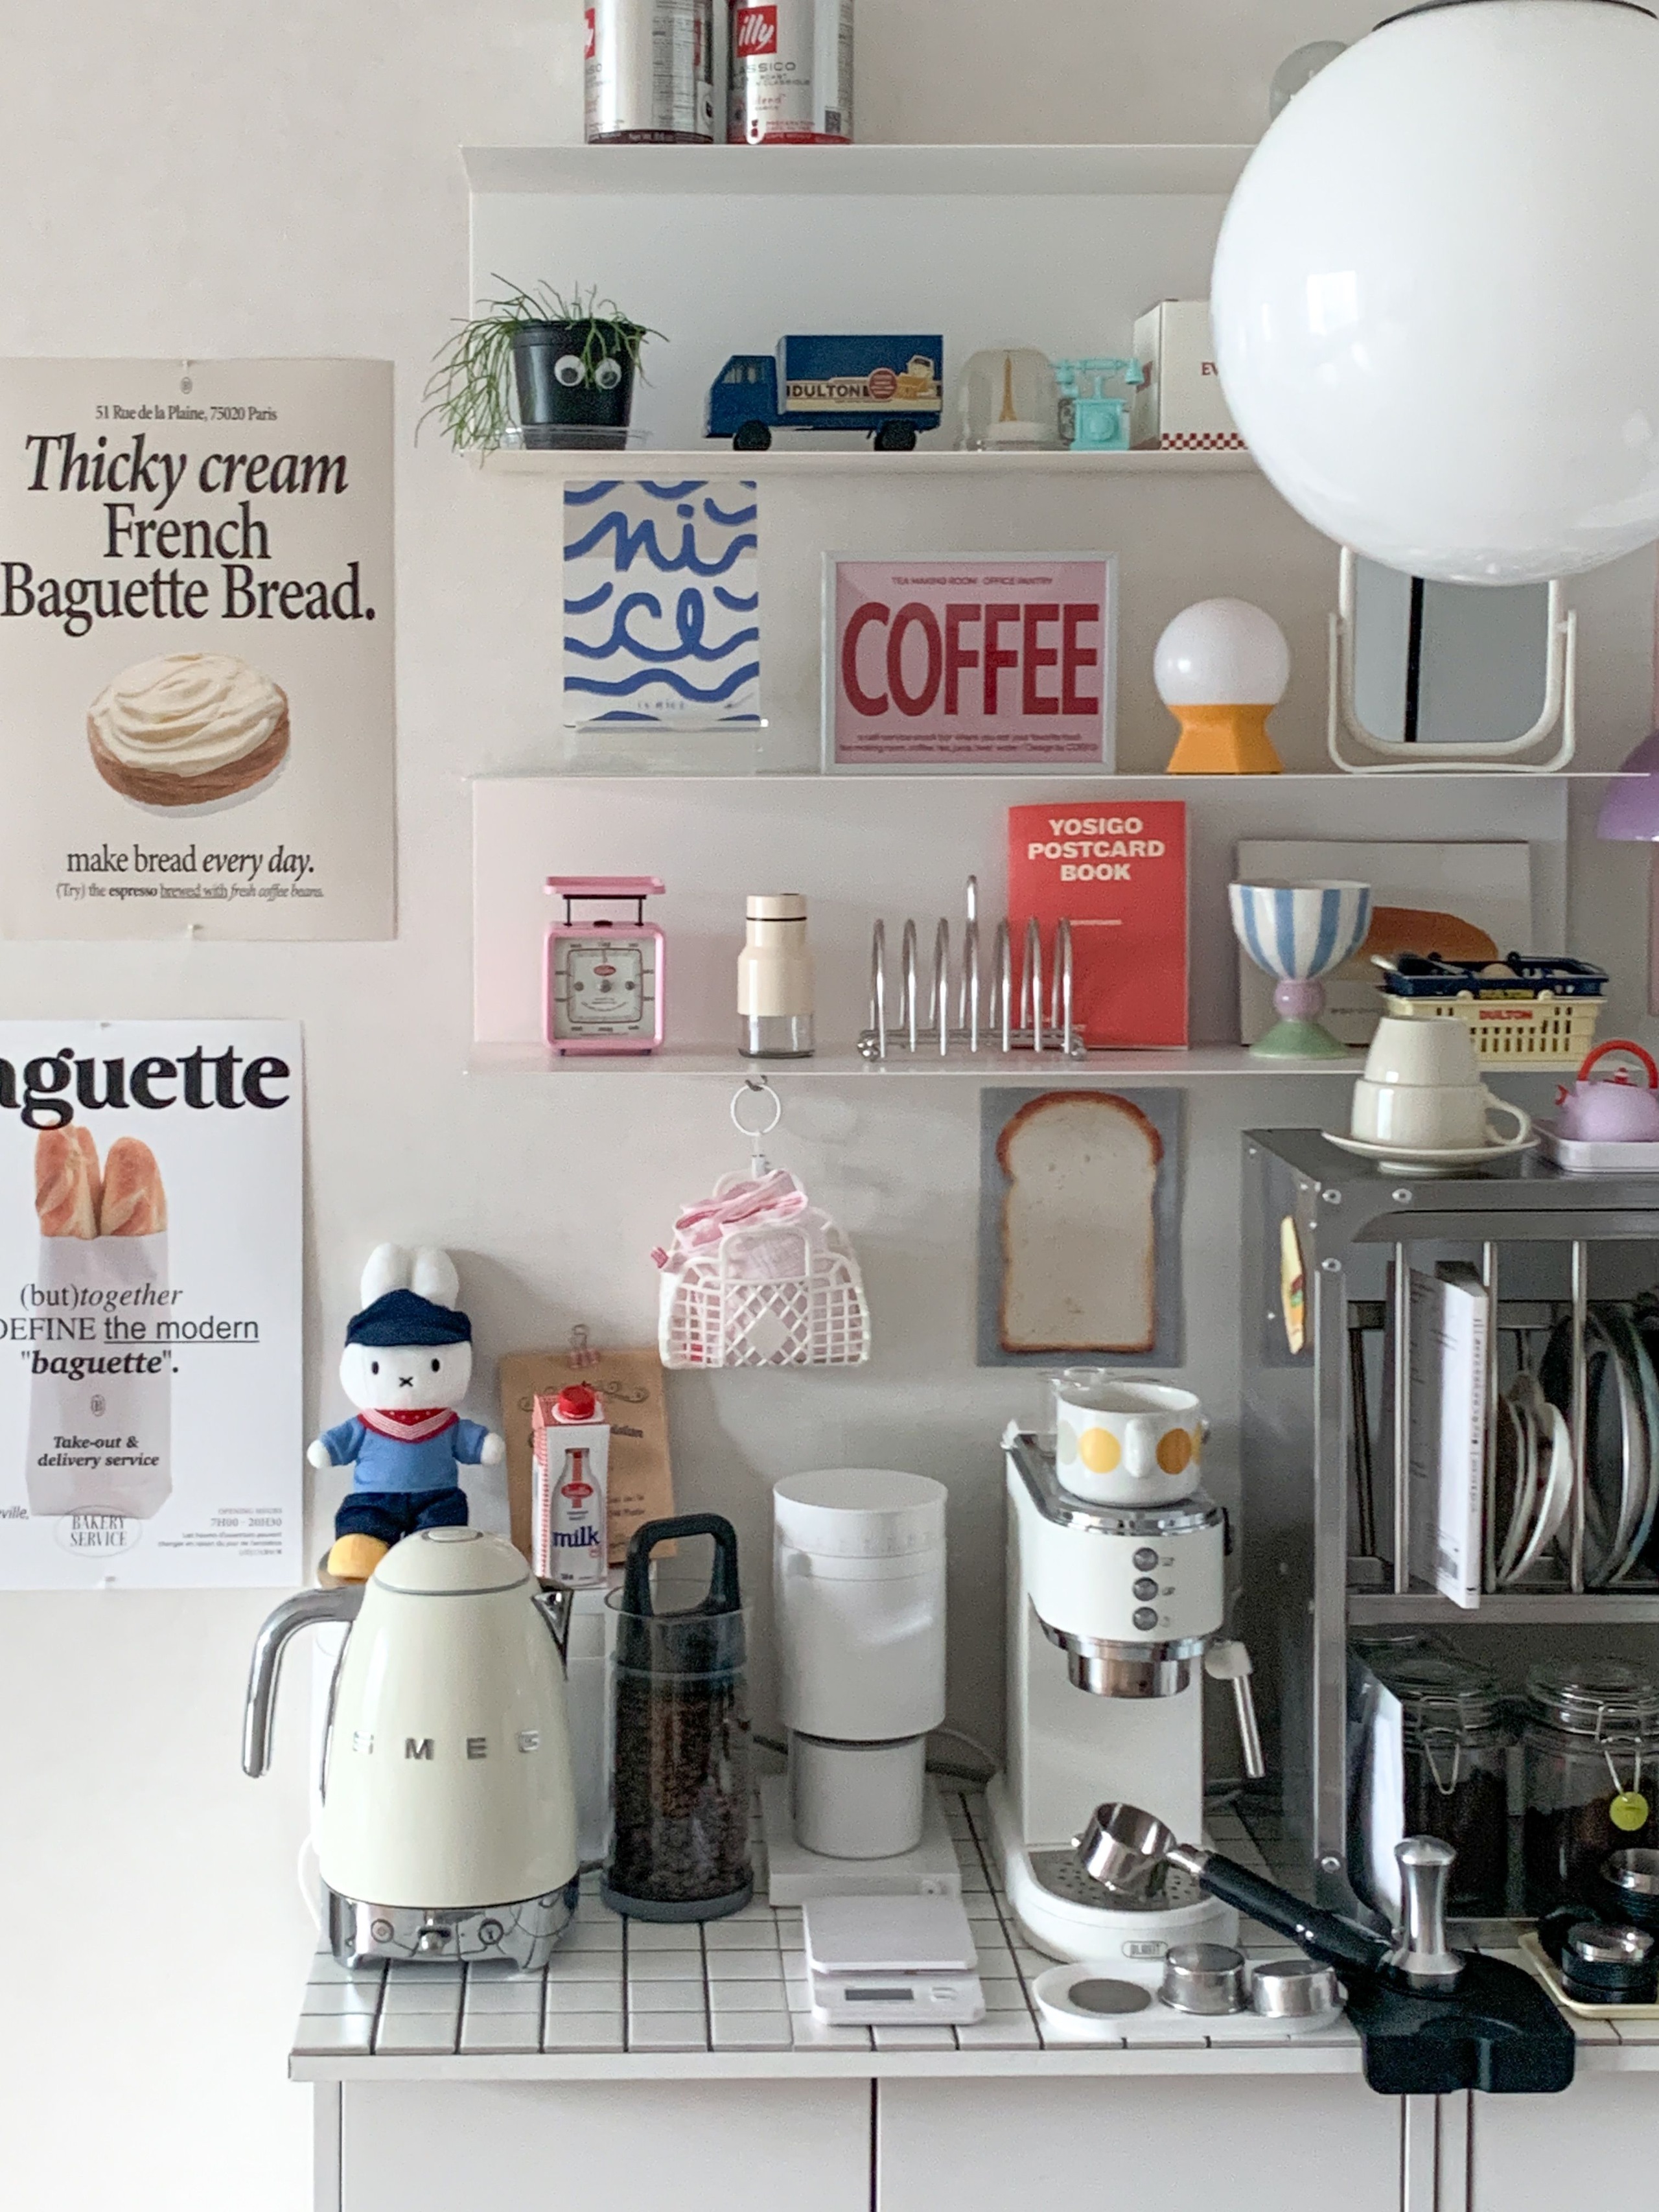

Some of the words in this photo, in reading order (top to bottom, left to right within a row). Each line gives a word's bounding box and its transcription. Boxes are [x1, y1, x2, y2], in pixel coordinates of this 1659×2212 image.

[739, 14, 774, 51] illy
[95, 405, 109, 420] 51
[113, 405, 137, 420] Rue
[137, 404, 153, 420] de
[154, 404, 165, 420] la
[167, 404, 208, 422] Plaine,
[210, 406, 245, 420] 75020
[248, 406, 277, 421] Paris
[25, 432, 187, 511] Thicky
[198, 454, 349, 494] cream
[103, 500, 272, 559] French
[0, 561, 209, 637] Baguette
[221, 561, 376, 620] Bread.
[842, 602, 1100, 717] COFFEE
[1049, 817, 1144, 836] YOSIGO
[1028, 839, 1166, 860] POSTCARD
[67, 844, 128, 872] make
[133, 844, 197, 872] bread
[203, 854, 262, 881] every
[268, 845, 315, 881] day.
[1060, 863, 1131, 881] BOOK
[56, 882, 86, 900] (Try)
[88, 882, 106, 896] the
[108, 885, 157, 900] espresso
[160, 882, 201, 897] brewed
[203, 882, 227, 897] with
[228, 882, 256, 901] fresh
[258, 882, 289, 901] coffee
[20, 1283, 183, 1312] (but)together
[104, 1316, 146, 1340] the
[157, 1316, 259, 1340] modern
[21, 1349, 179, 1380] "baguette".
[53, 1436, 122, 1449] Take-out
[126, 1436, 139, 1449] &
[37, 1454, 100, 1469] delivery
[105, 1454, 159, 1467] service
[72, 1515, 125, 1530] BAKERY
[70, 1531, 128, 1547] SERVICE
[552, 1525, 600, 1548] milk
